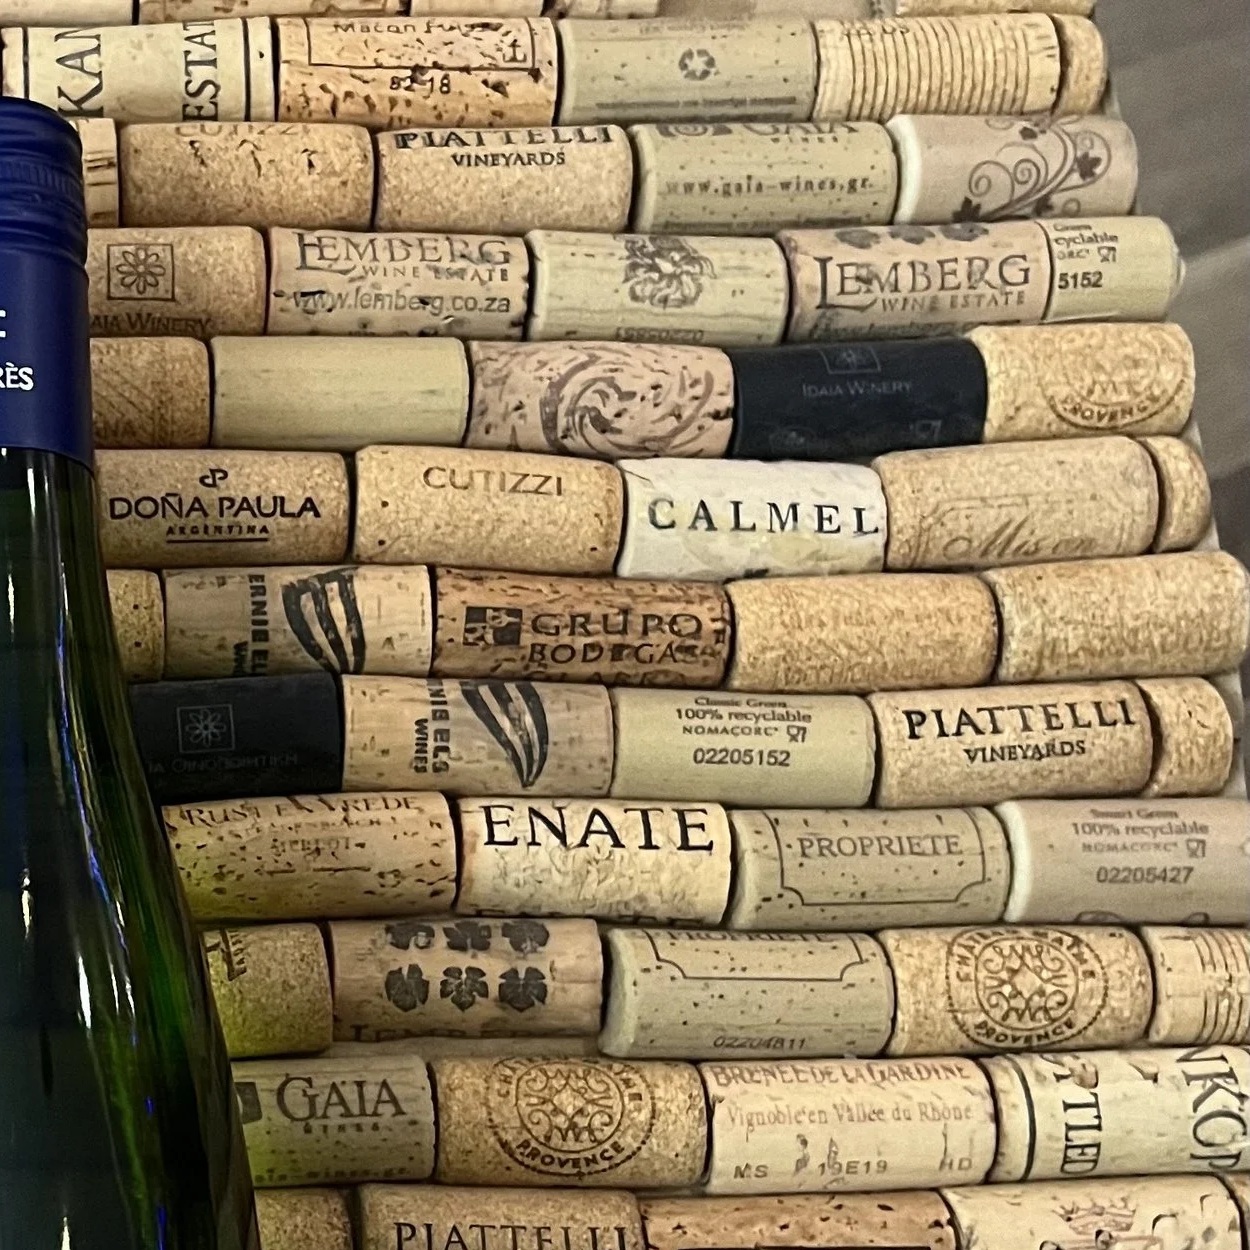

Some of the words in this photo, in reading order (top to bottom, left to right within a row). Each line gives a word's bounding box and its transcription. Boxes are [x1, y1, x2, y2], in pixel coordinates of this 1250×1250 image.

[451, 152, 565, 167] VINEYARDS
[812, 254, 1031, 310] LEMBERG
[423, 466, 564, 497] CUTIZZI
[109, 493, 209, 520] DOÑA
[219, 495, 321, 519] PAULA
[648, 499, 881, 536] CALMEL
[676, 709, 723, 723] 100%
[728, 710, 813, 725] recyclable
[906, 700, 1137, 740] PIATTELLI
[693, 747, 791, 768] 02205152
[963, 740, 1087, 765] VINEYARDS
[481, 803, 715, 852] ENATE
[1071, 823, 1118, 837] 100%
[1124, 823, 1210, 838] recyclable
[1095, 865, 1195, 887] 02205427
[515, 1140, 626, 1171] PROVENCE
